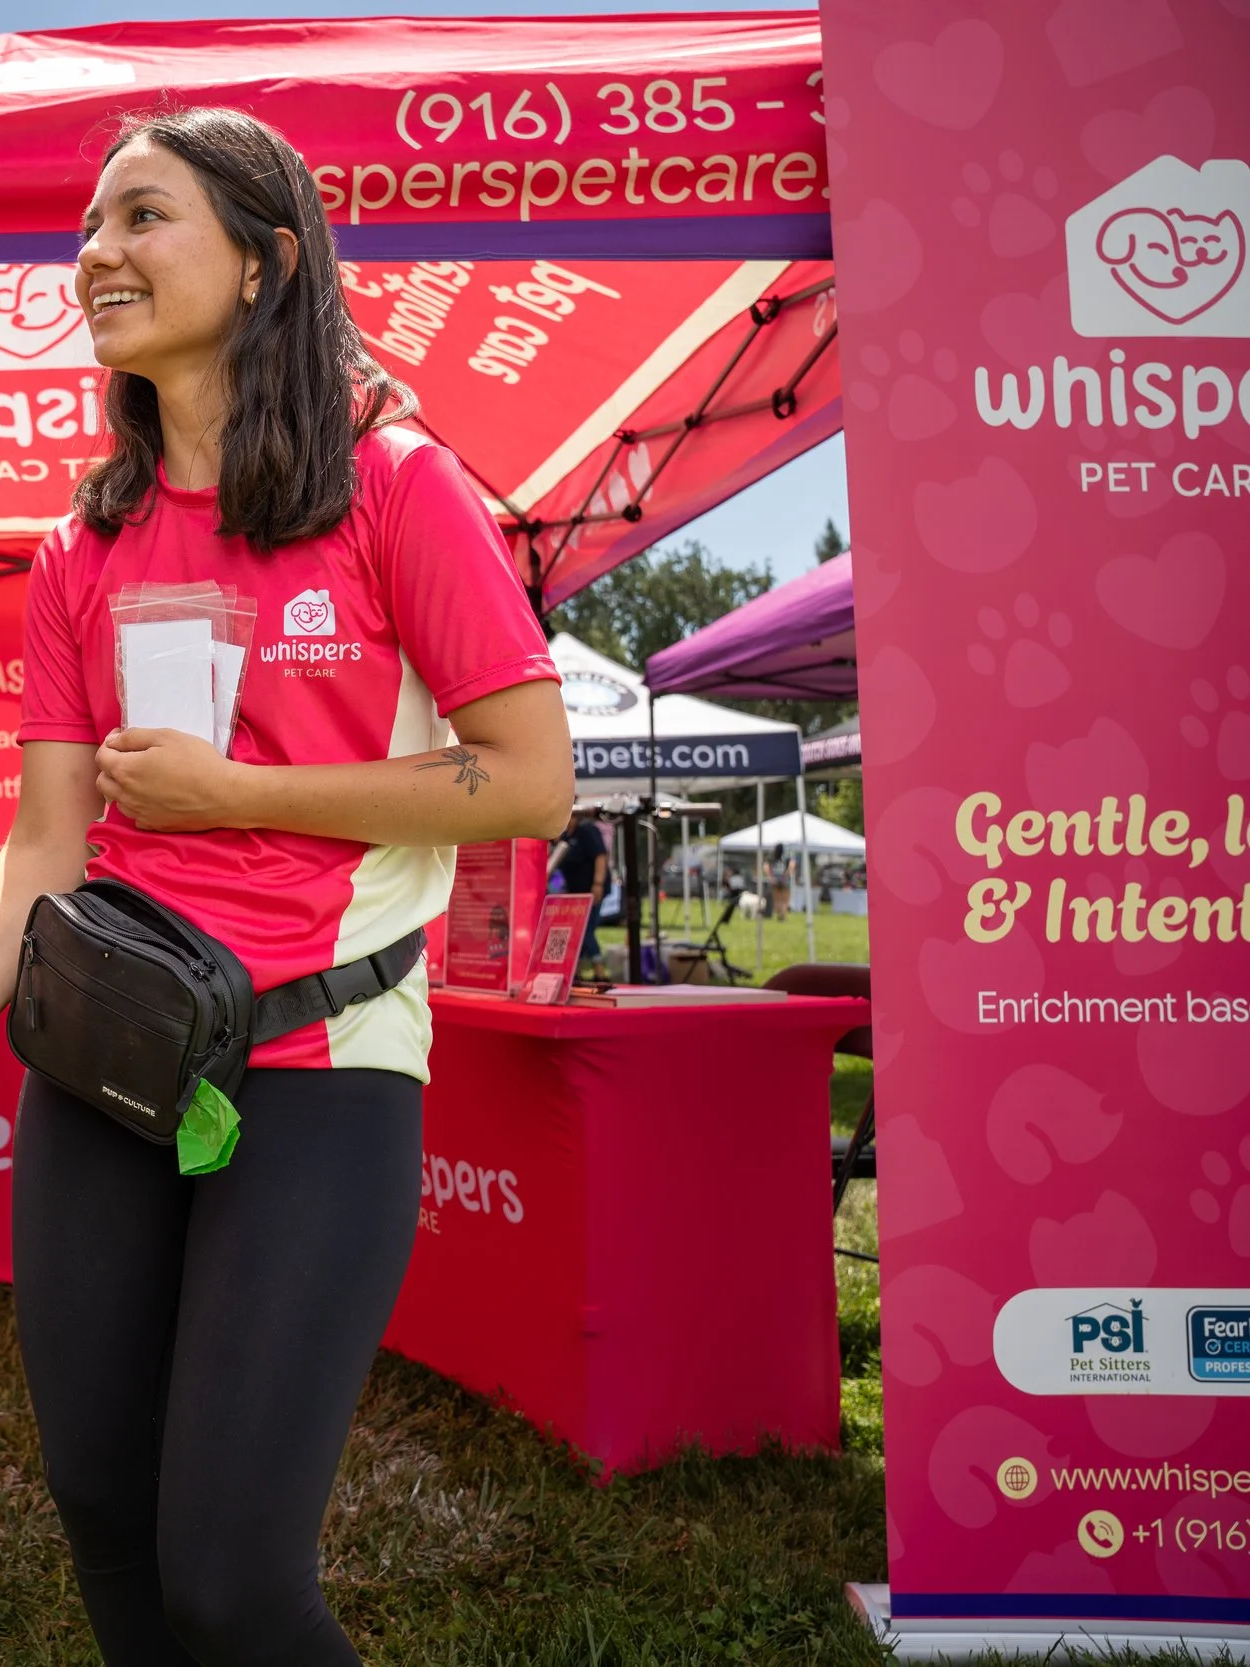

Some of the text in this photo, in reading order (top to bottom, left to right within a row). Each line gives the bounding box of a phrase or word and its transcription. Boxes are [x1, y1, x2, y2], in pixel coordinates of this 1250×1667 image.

[395, 82, 572, 150] (916)
[597, 76, 735, 136] 385
[974, 348, 1250, 440] whisp
[1080, 462, 1156, 493] PET
[260, 639, 362, 664] whispers
[284, 668, 337, 678] PET CARE
[955, 791, 1250, 869] Gentle, l
[963, 877, 1032, 944] &
[978, 990, 1250, 1024] Enrichment bas
[102, 1086, 156, 1117] PUP CULTURE
[1204, 1317, 1250, 1337] Fear
[1070, 1357, 1151, 1371] Pet Sitters
[1070, 1373, 1151, 1382] INTERNATIONAL
[1132, 1516, 1250, 1555] +1 (916
